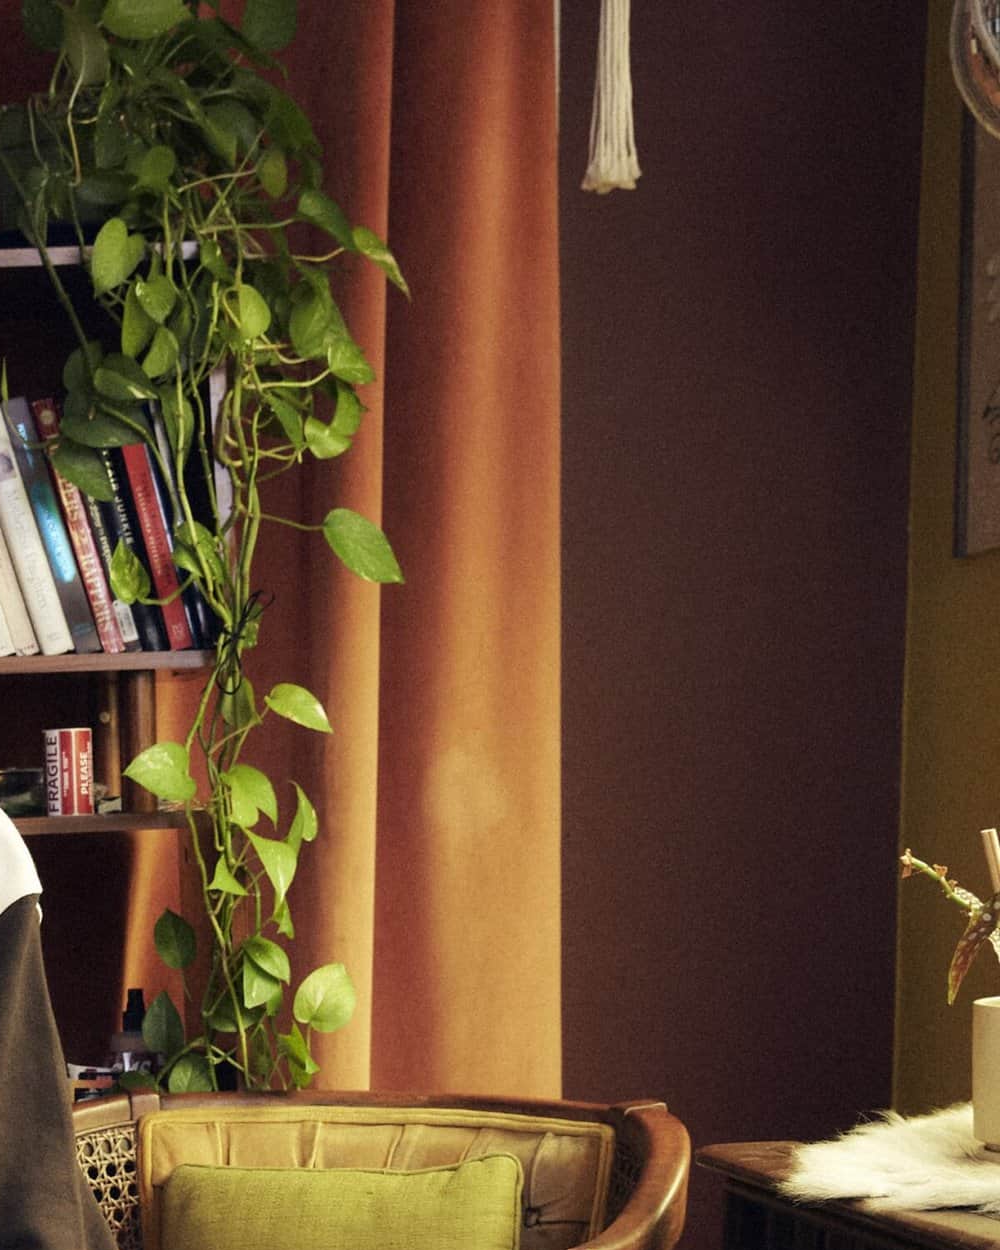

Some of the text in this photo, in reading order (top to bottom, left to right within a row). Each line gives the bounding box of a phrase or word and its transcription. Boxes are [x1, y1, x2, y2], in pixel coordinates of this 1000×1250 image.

[116, 496, 134, 544] JUNKIE
[47, 736, 59, 812] FRAGILE
[80, 751, 89, 795] PLEASE
